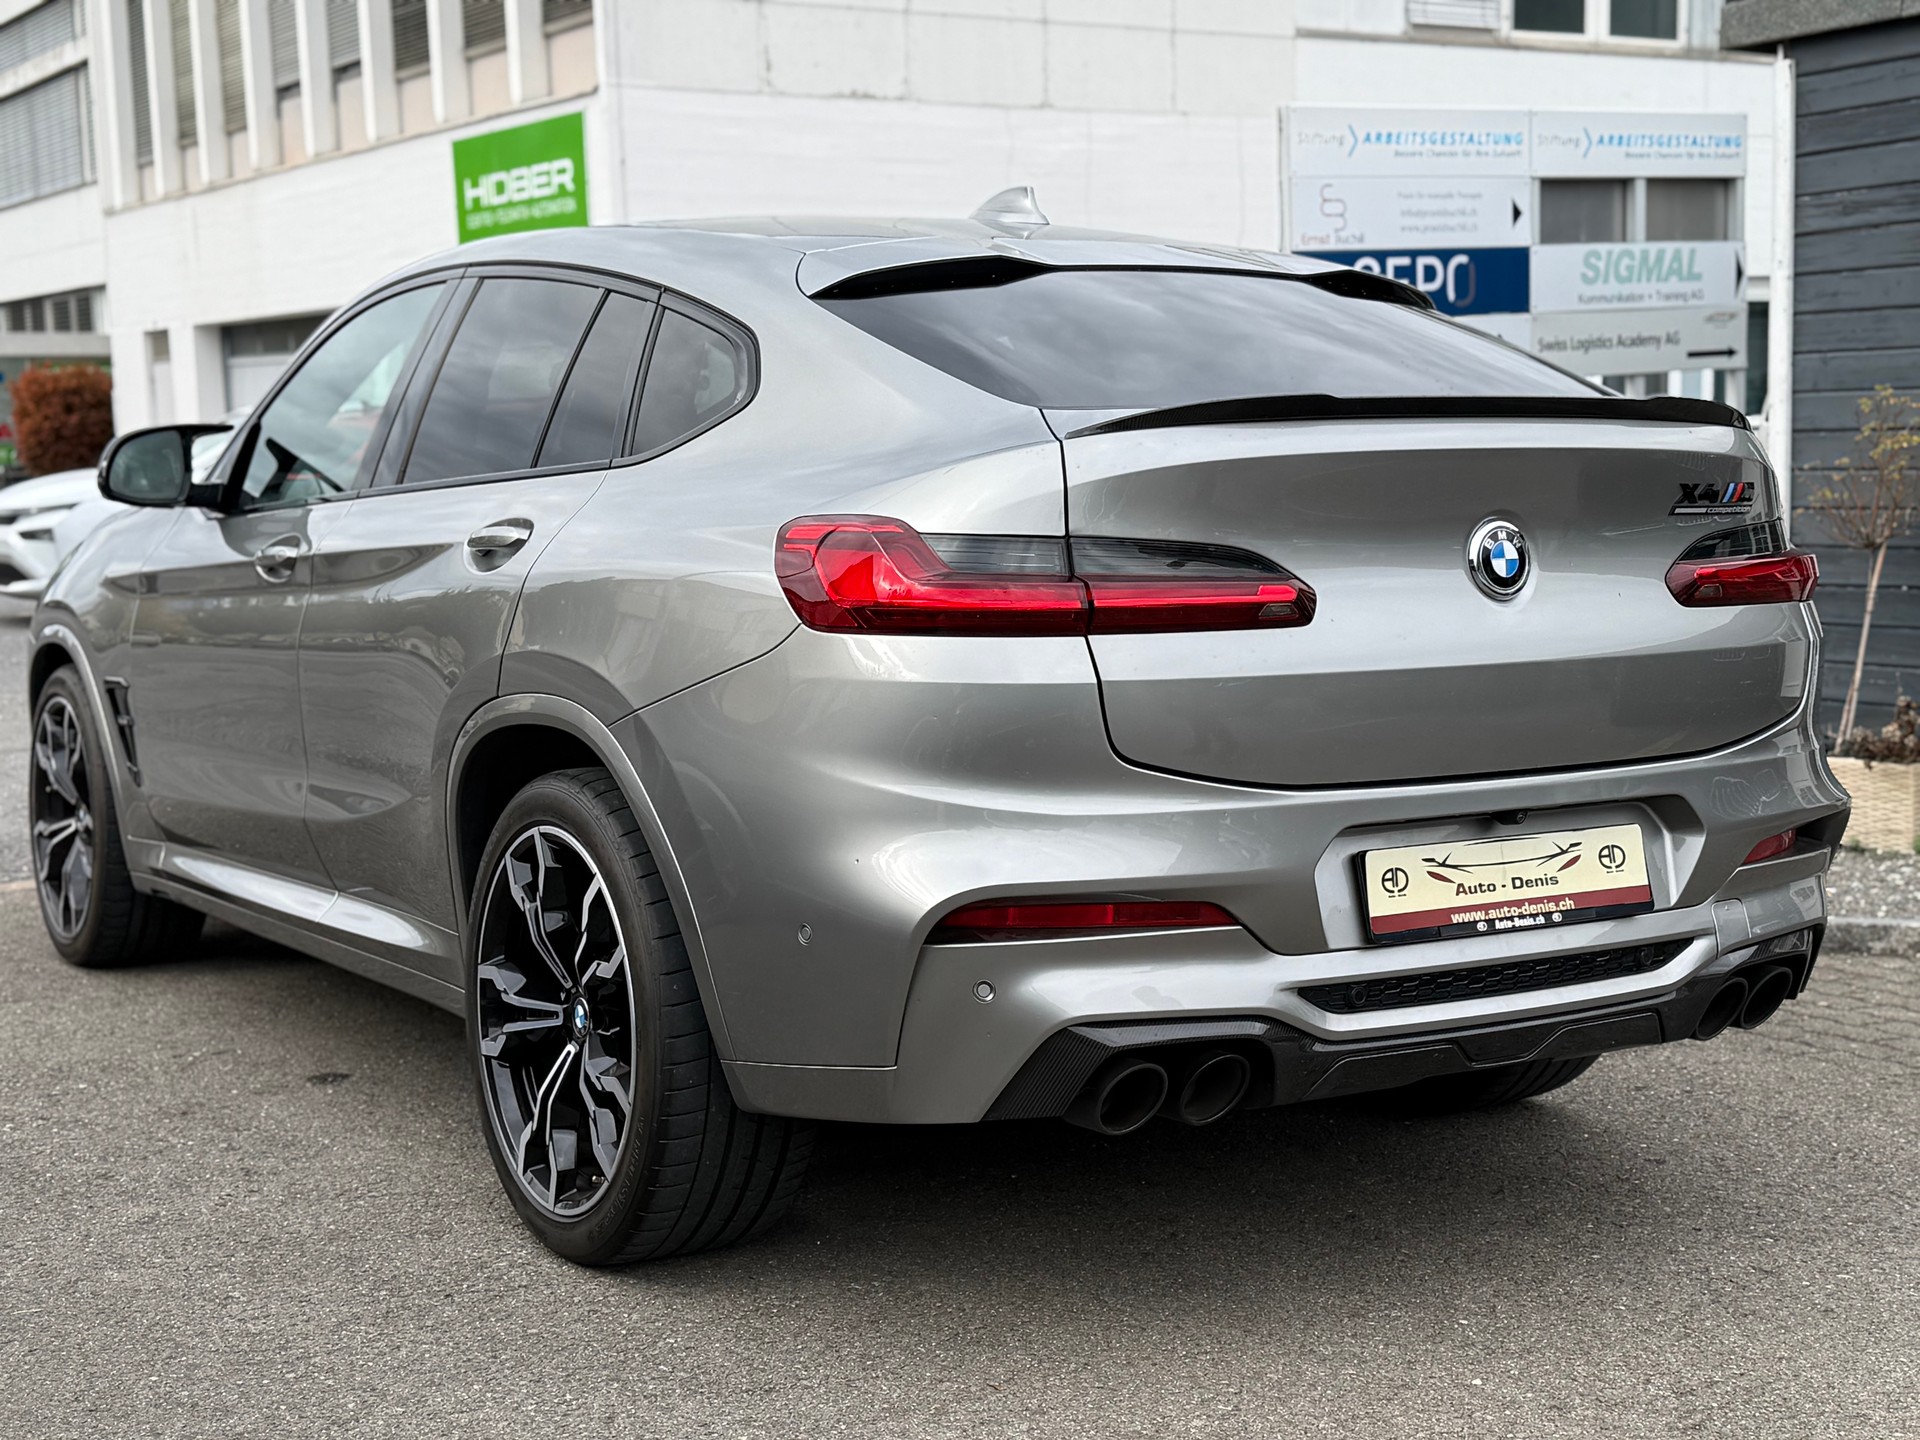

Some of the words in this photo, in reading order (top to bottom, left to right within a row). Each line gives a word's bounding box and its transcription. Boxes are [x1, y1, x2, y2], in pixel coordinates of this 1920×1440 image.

[1362, 131, 1524, 146] ARBEITSGESTALTUNG
[1596, 134, 1742, 148] ARBEITSGESTALTUNG
[1580, 248, 1703, 285] SIGMAL
[1577, 291, 1645, 305] Kommunikation
[1537, 336, 1568, 353] Swiss
[1570, 333, 1613, 354] Logistics
[1616, 332, 1662, 350] Academy
[1665, 331, 1681, 346] AG
[1484, 529, 1522, 550] BMW
[1455, 881, 1497, 897] Auto
[1511, 873, 1559, 890] Denis
[1451, 897, 1575, 923] www.auto-denis.ch
